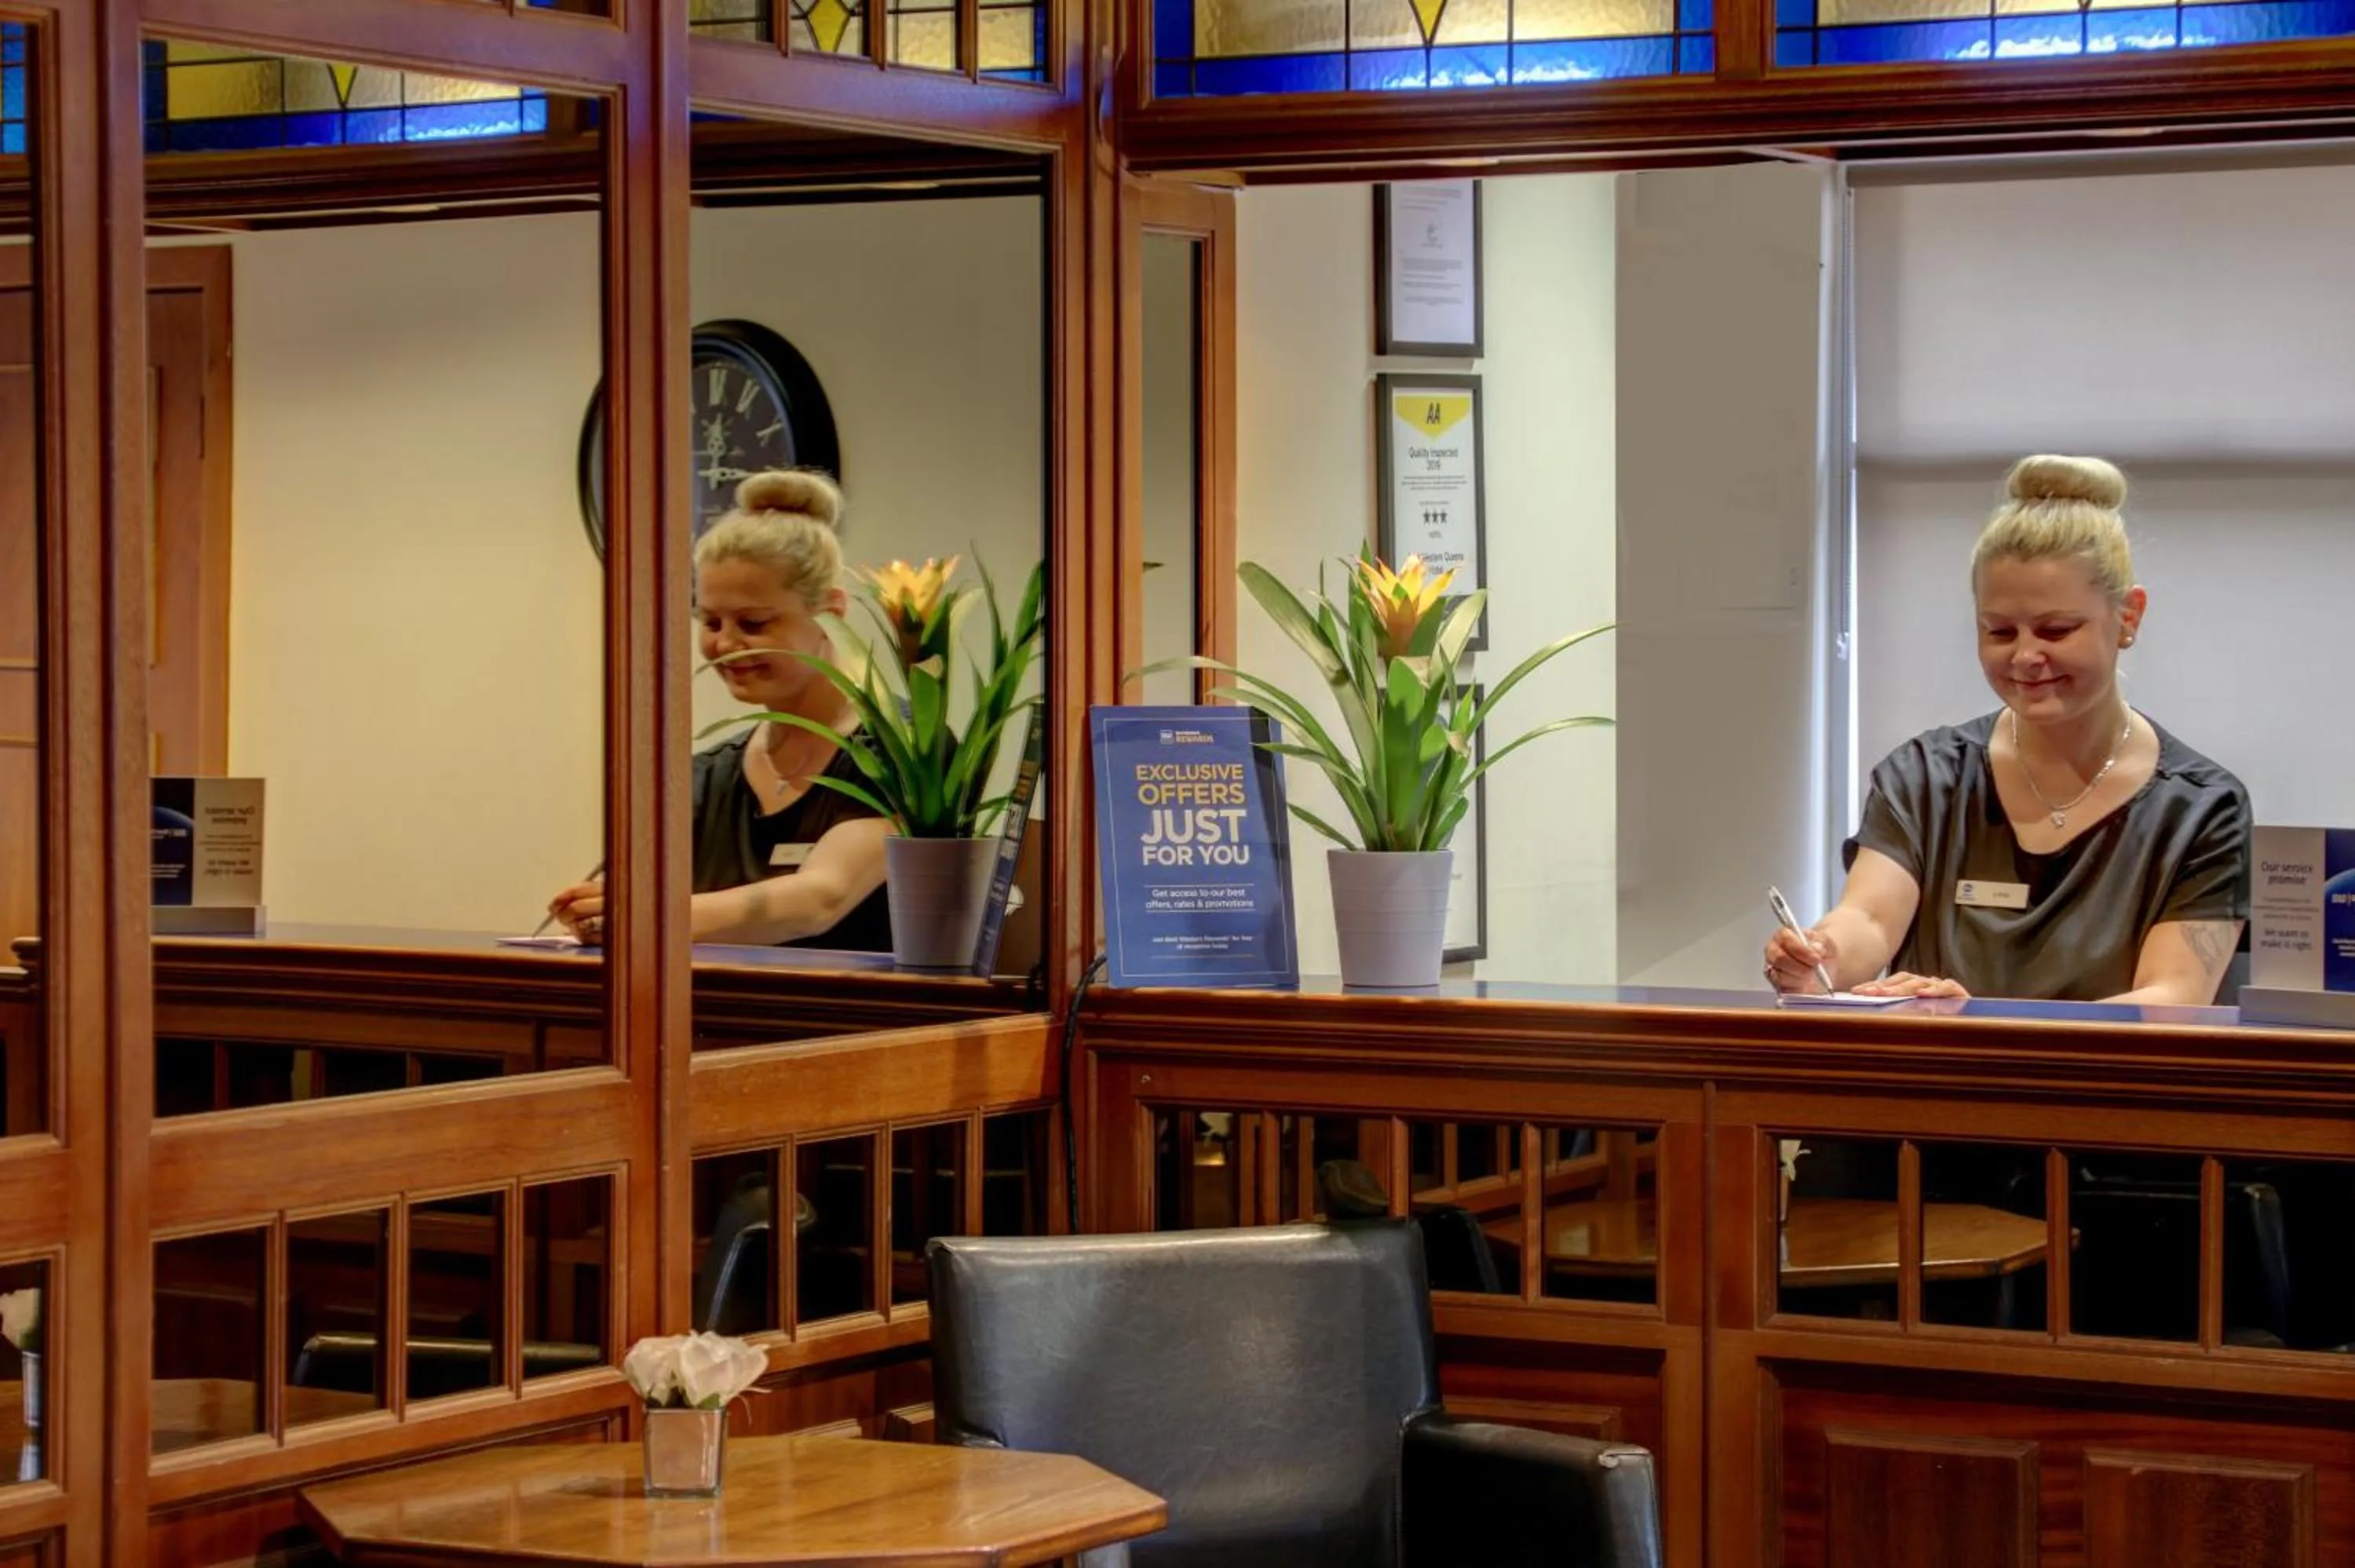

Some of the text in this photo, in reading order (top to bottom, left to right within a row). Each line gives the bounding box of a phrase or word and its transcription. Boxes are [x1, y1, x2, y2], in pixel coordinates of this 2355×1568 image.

[1426, 402, 1441, 425] AA
[1408, 446, 1458, 459] Quality Inspected
[1136, 764, 1244, 781] EXCLUSIVE
[1138, 782, 1246, 805] OFFERS
[1141, 809, 1247, 844] JUST
[1142, 844, 1250, 866] FOR YOU
[2261, 860, 2280, 872] Our
[1152, 888, 1168, 898] Get
[1170, 889, 1198, 898] access
[1199, 888, 1209, 897] to
[1226, 888, 1246, 897] best
[1145, 899, 1254, 910] offers, rates & promotions
